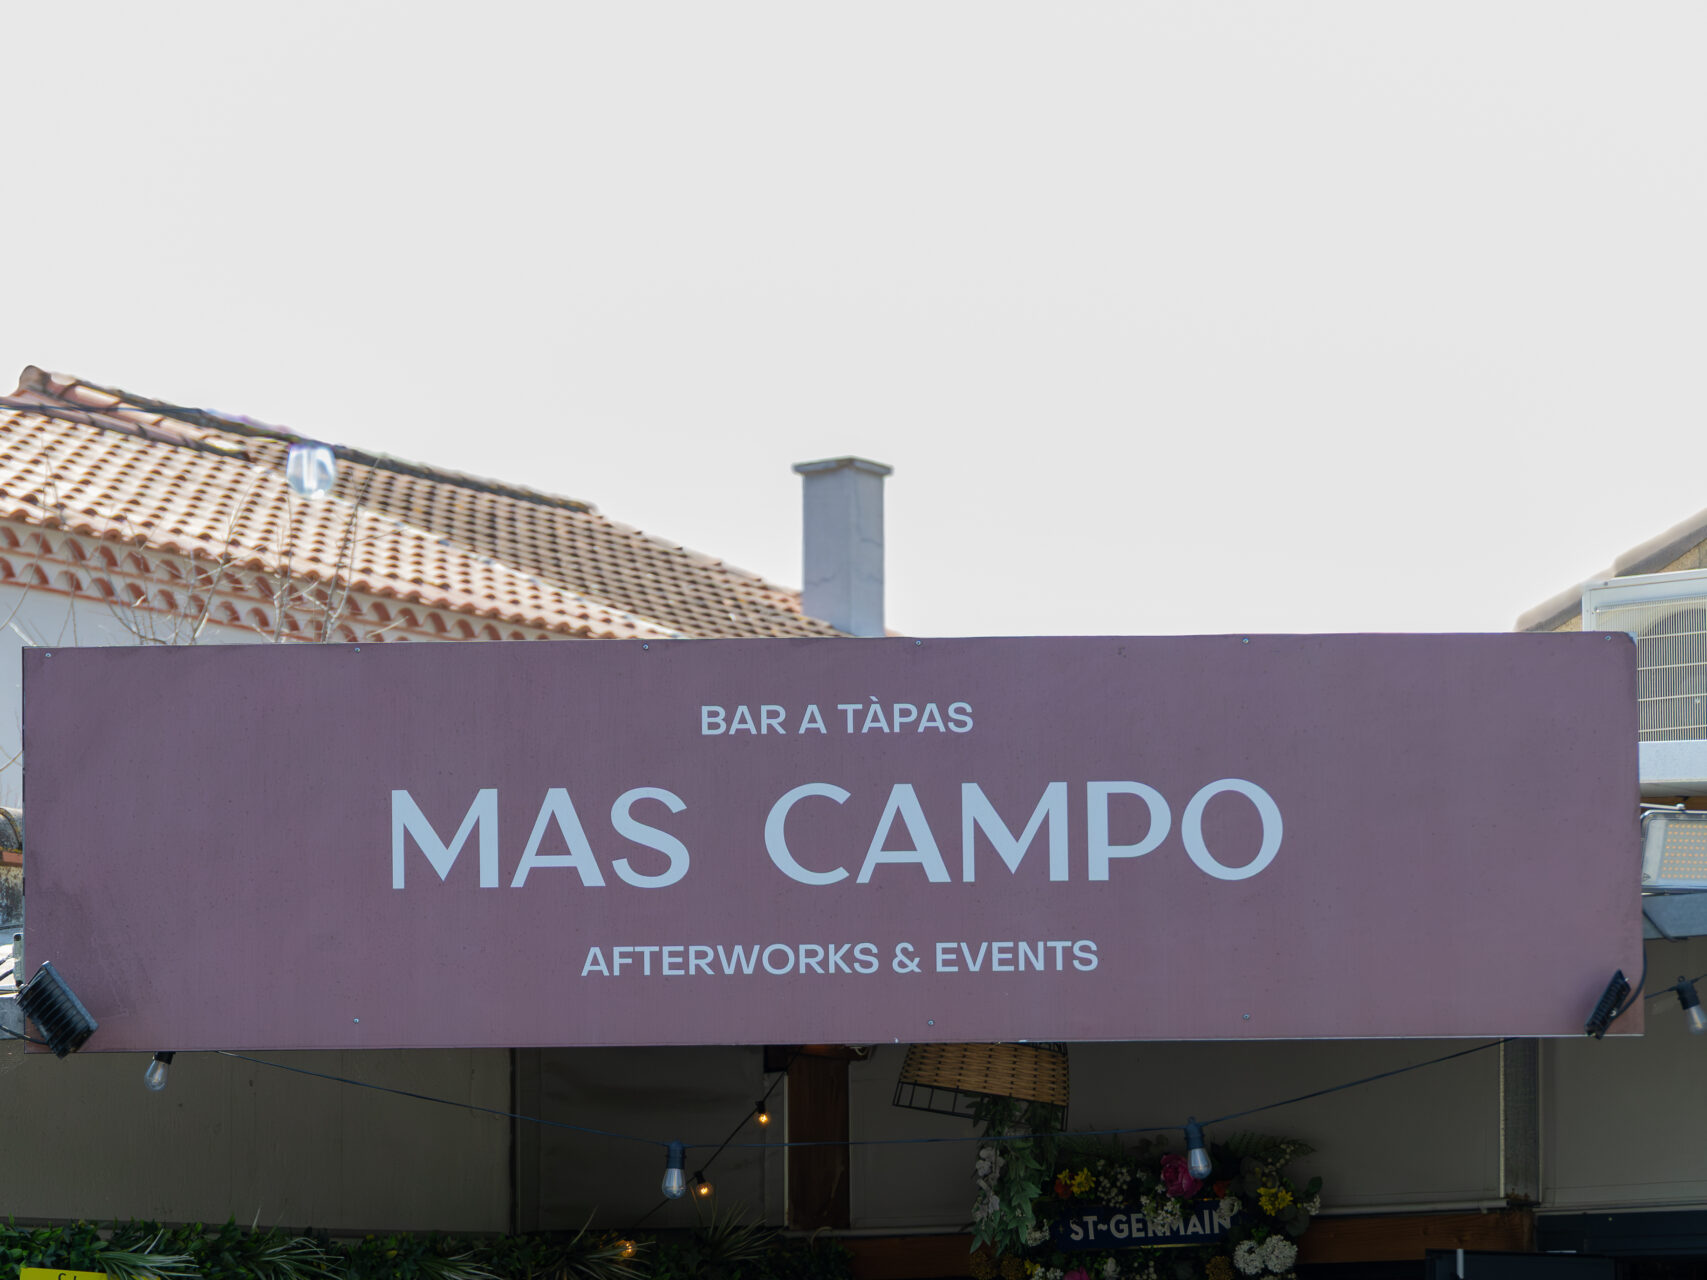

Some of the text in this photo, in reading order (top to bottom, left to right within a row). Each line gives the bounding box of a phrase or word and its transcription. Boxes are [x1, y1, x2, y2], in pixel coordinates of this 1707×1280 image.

[702, 696, 973, 735] BAR A TÀPAS
[392, 779, 1283, 889] MAS CAMPO
[582, 940, 1098, 976] AFTERWORKS & EVENTS
